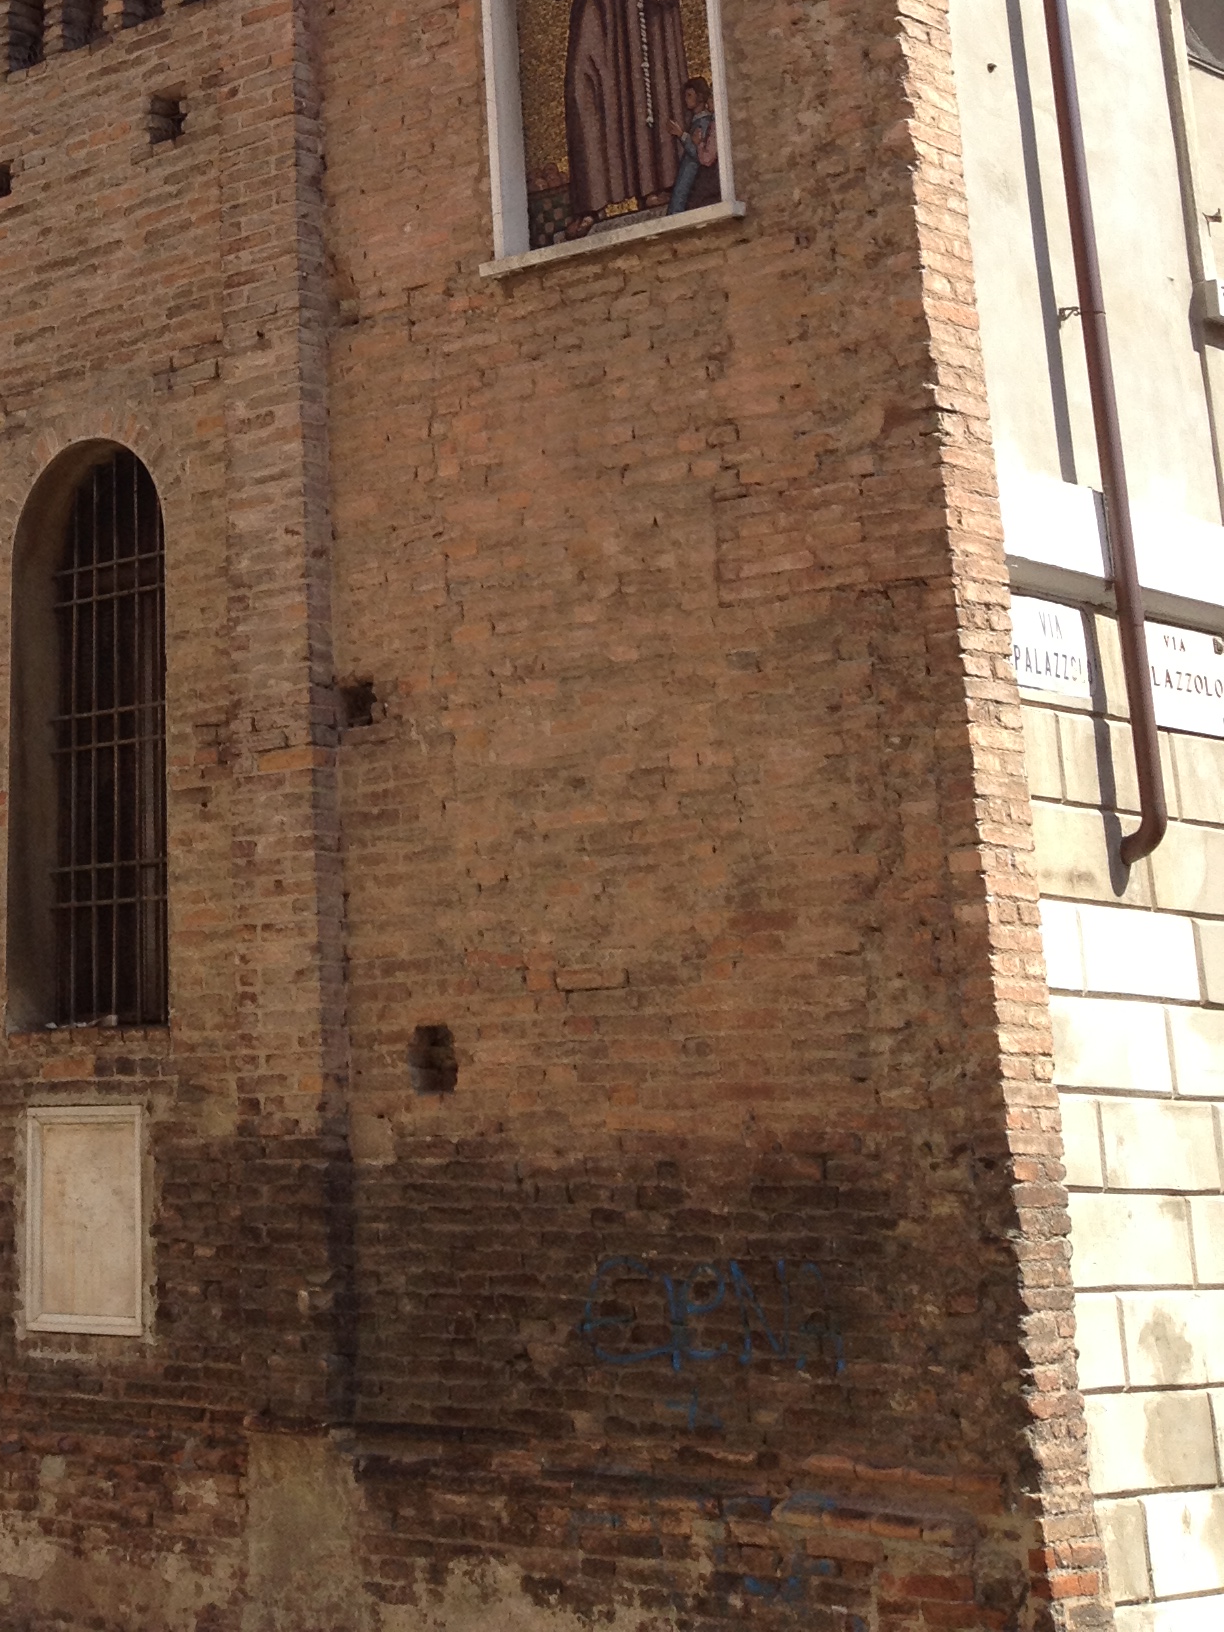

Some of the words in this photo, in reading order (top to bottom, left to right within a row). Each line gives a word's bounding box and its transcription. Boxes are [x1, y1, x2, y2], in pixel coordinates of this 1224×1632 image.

[1038, 611, 1063, 639] VIA
[1163, 634, 1186, 652] VIA
[1151, 665, 1223, 699] LAZZOLO
